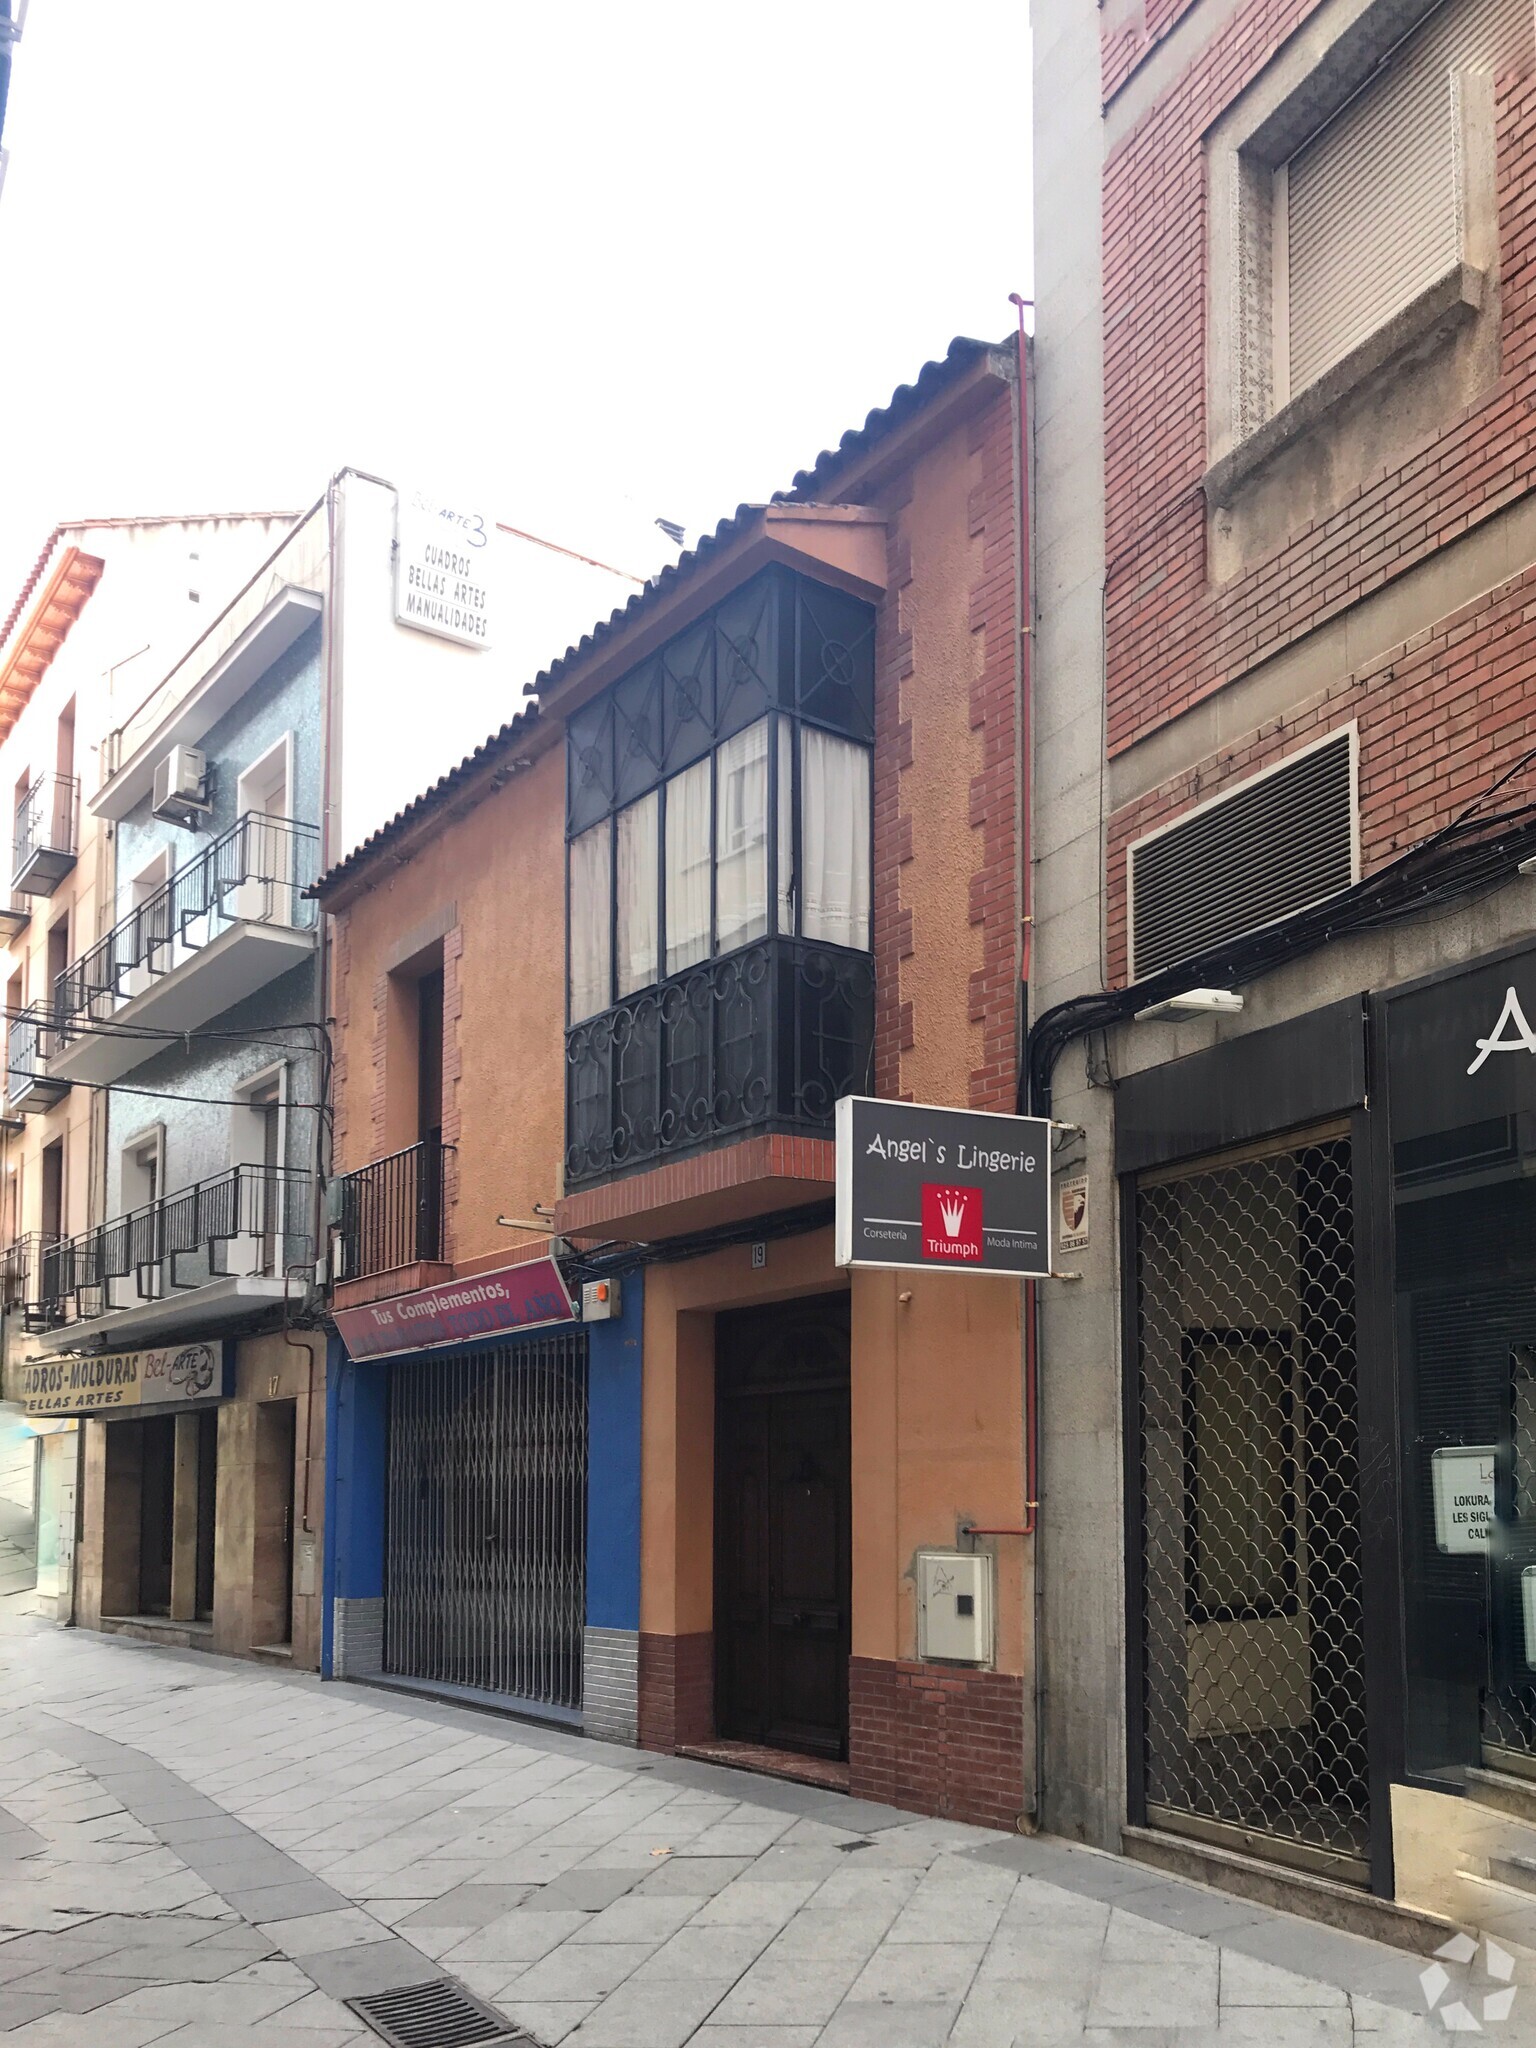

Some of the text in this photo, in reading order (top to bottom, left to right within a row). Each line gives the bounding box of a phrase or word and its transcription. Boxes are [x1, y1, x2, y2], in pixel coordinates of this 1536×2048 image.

[425, 544, 471, 577] CUADROS
[408, 565, 486, 609] BELLAS ARTES
[406, 593, 487, 637] MANUALIDADES
[957, 1144, 1036, 1173] Lingerie
[927, 1239, 978, 1258] Triumph
[986, 1236, 1010, 1248] Moda
[754, 1246, 763, 1264] 19
[371, 1308, 394, 1326] Tus
[24, 1354, 139, 1395] ADROS-MOLDURAS
[268, 1375, 279, 1396] 17
[25, 1390, 124, 1411] ELLAS ARTES
[1454, 1495, 1491, 1506] LOKURA
[1453, 1512, 1468, 1523] LES
